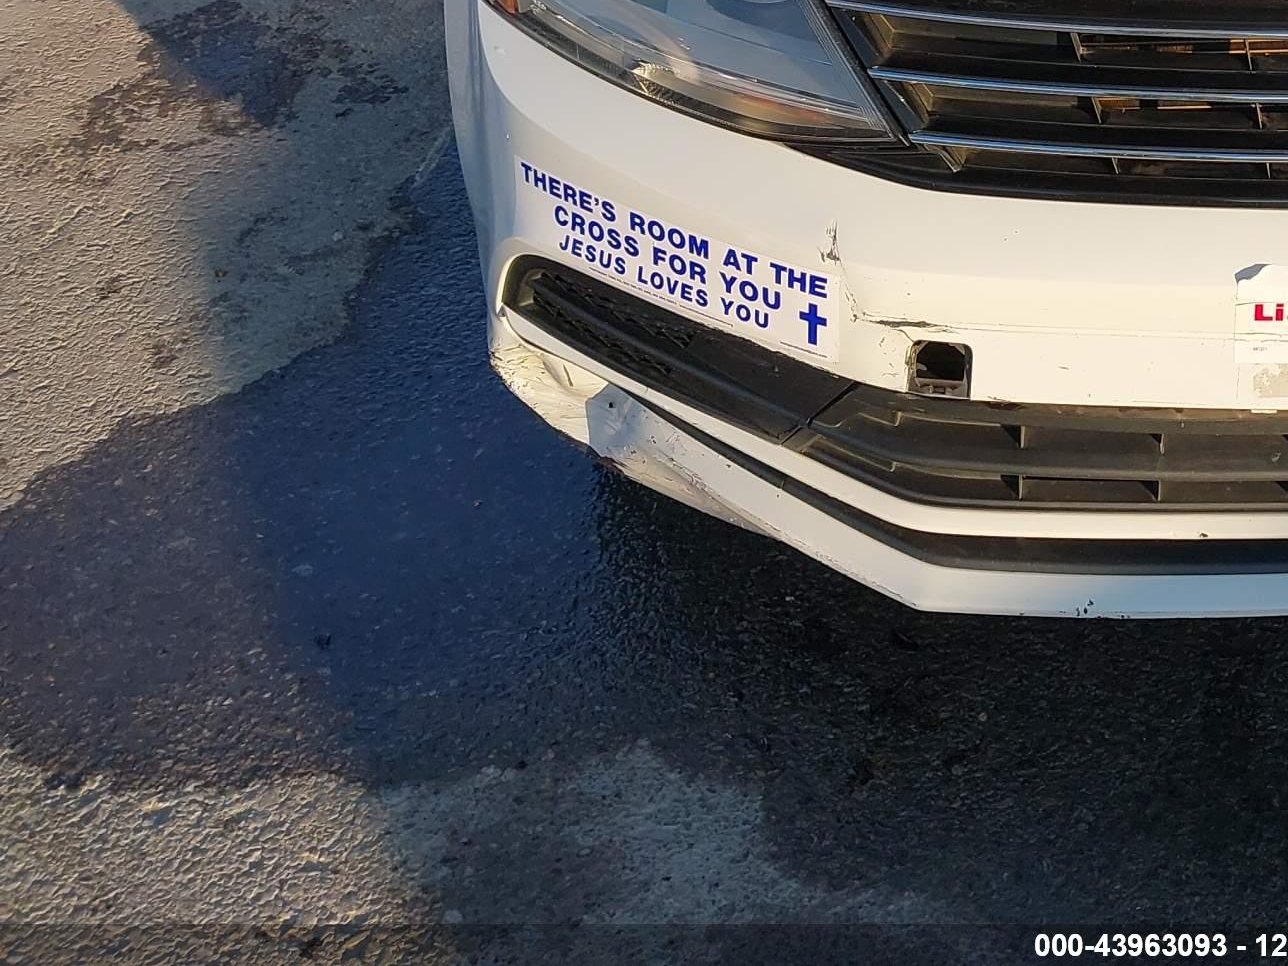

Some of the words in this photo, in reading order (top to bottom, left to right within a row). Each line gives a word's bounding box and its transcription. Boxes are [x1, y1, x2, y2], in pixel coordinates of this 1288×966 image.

[520, 162, 617, 222] THERE'S
[629, 211, 710, 260] ROOM
[723, 248, 758, 276] AT
[769, 261, 828, 299] THE
[554, 205, 640, 257] CROSS
[652, 246, 707, 284] FOR
[719, 272, 782, 310] YOU
[559, 234, 626, 275] JESUS
[637, 265, 709, 308] LOVES
[720, 297, 770, 330] YOU
